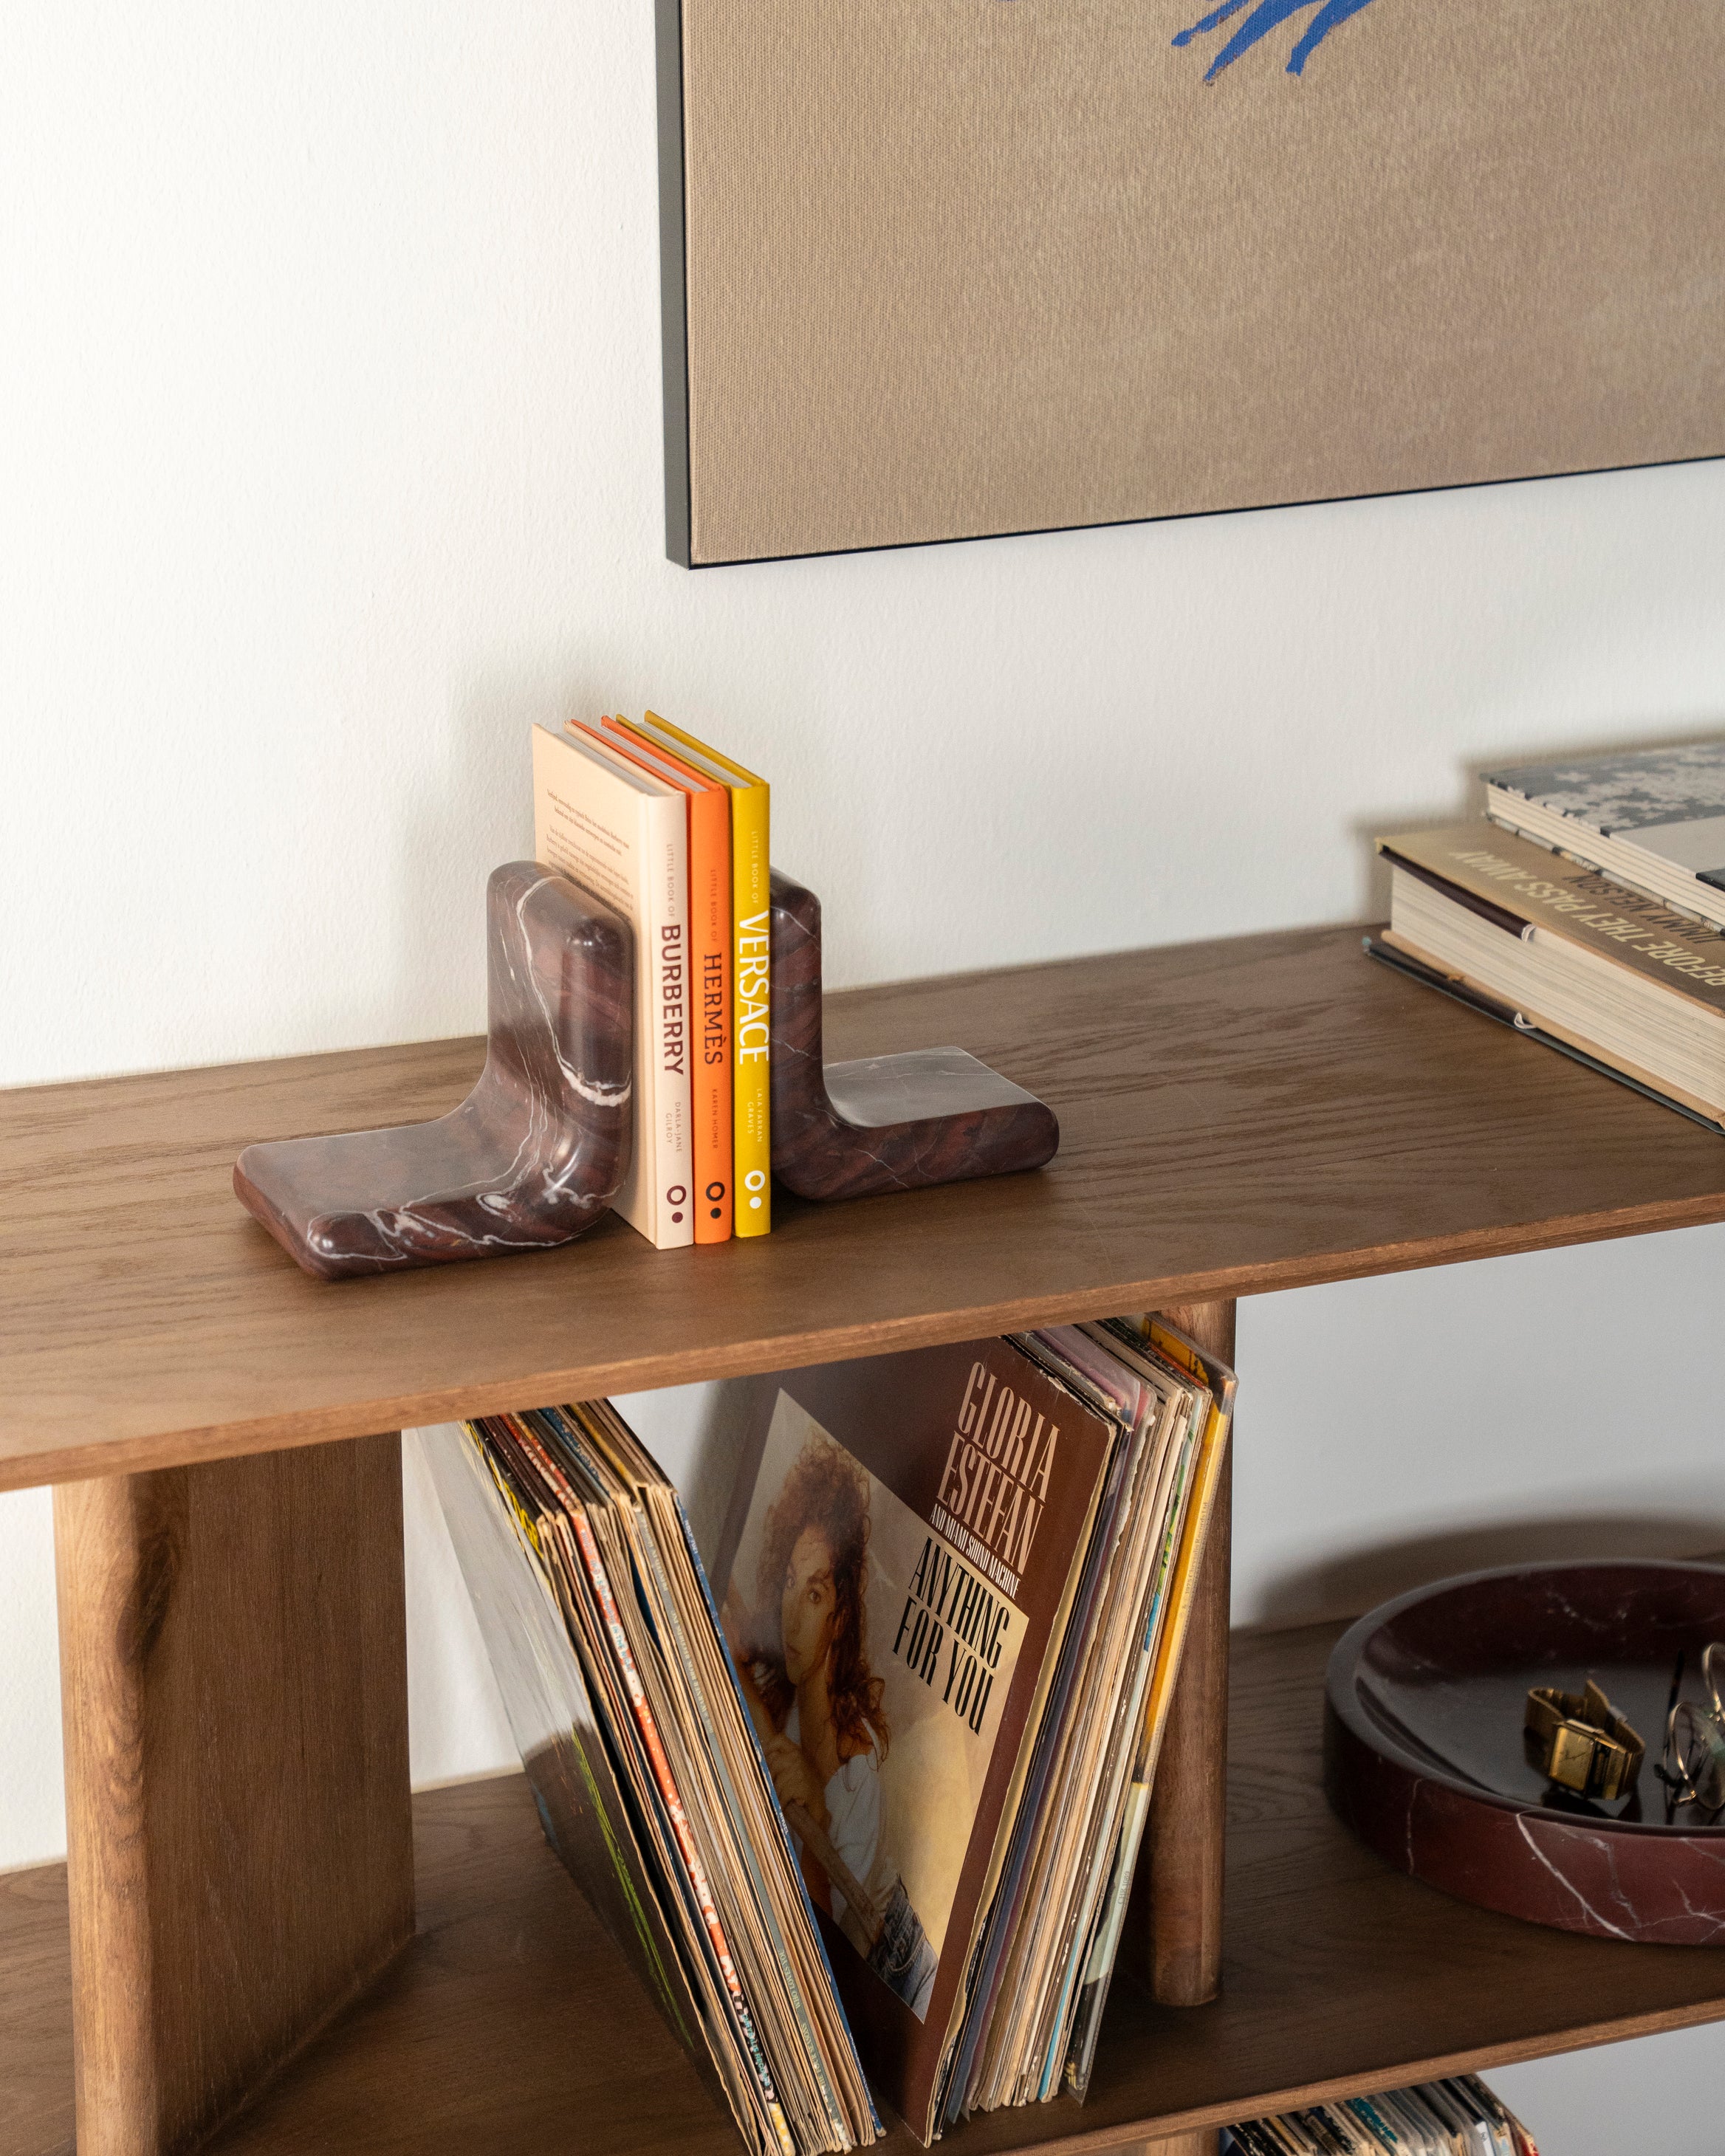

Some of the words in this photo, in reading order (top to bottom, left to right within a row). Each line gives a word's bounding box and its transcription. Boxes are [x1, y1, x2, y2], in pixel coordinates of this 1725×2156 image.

[1448, 850, 1538, 880] AWAY
[751, 893, 758, 904] OF
[1513, 881, 1598, 913] PASS
[1561, 874, 1661, 913] NELSON
[668, 906, 675, 917] OF
[1569, 913, 1655, 942] THEY
[710, 930, 717, 941] OF
[1639, 914, 1725, 944] JIMMY
[1630, 941, 1725, 986] BEFORE
[662, 924, 684, 1075] BURBERRY
[738, 910, 769, 1065] VERSACE
[704, 952, 727, 1065] HERMÈS
[958, 1361, 1061, 1503] GLORIA
[936, 1430, 1044, 1576] ESTEFAN
[929, 1503, 947, 1531] AND
[944, 1515, 970, 1552] MIAMI
[966, 1535, 991, 1572] SOUND
[987, 1554, 1021, 1601] MACHINE
[1188, 1544, 1199, 1578] Chrysalis
[1196, 1514, 1205, 1544] Records
[908, 1536, 1011, 1670] ANYTHING
[611, 1625, 619, 1634] IN
[615, 1635, 625, 1649] THE
[893, 1595, 944, 1688] FOR
[943, 1637, 995, 1737] YOU
[693, 1680, 707, 1712] WARNER
[1121, 1870, 1131, 1886] 1089
[1117, 1886, 1127, 1905] CHR
[778, 1949, 787, 1966] YOU
[783, 1966, 795, 1991] LOVES
[791, 1990, 800, 2009] WHO
[741, 2013, 759, 2053] CHRYSALIS
[754, 2053, 772, 2087] RECORDS
[800, 2022, 815, 2053] SEASONS
